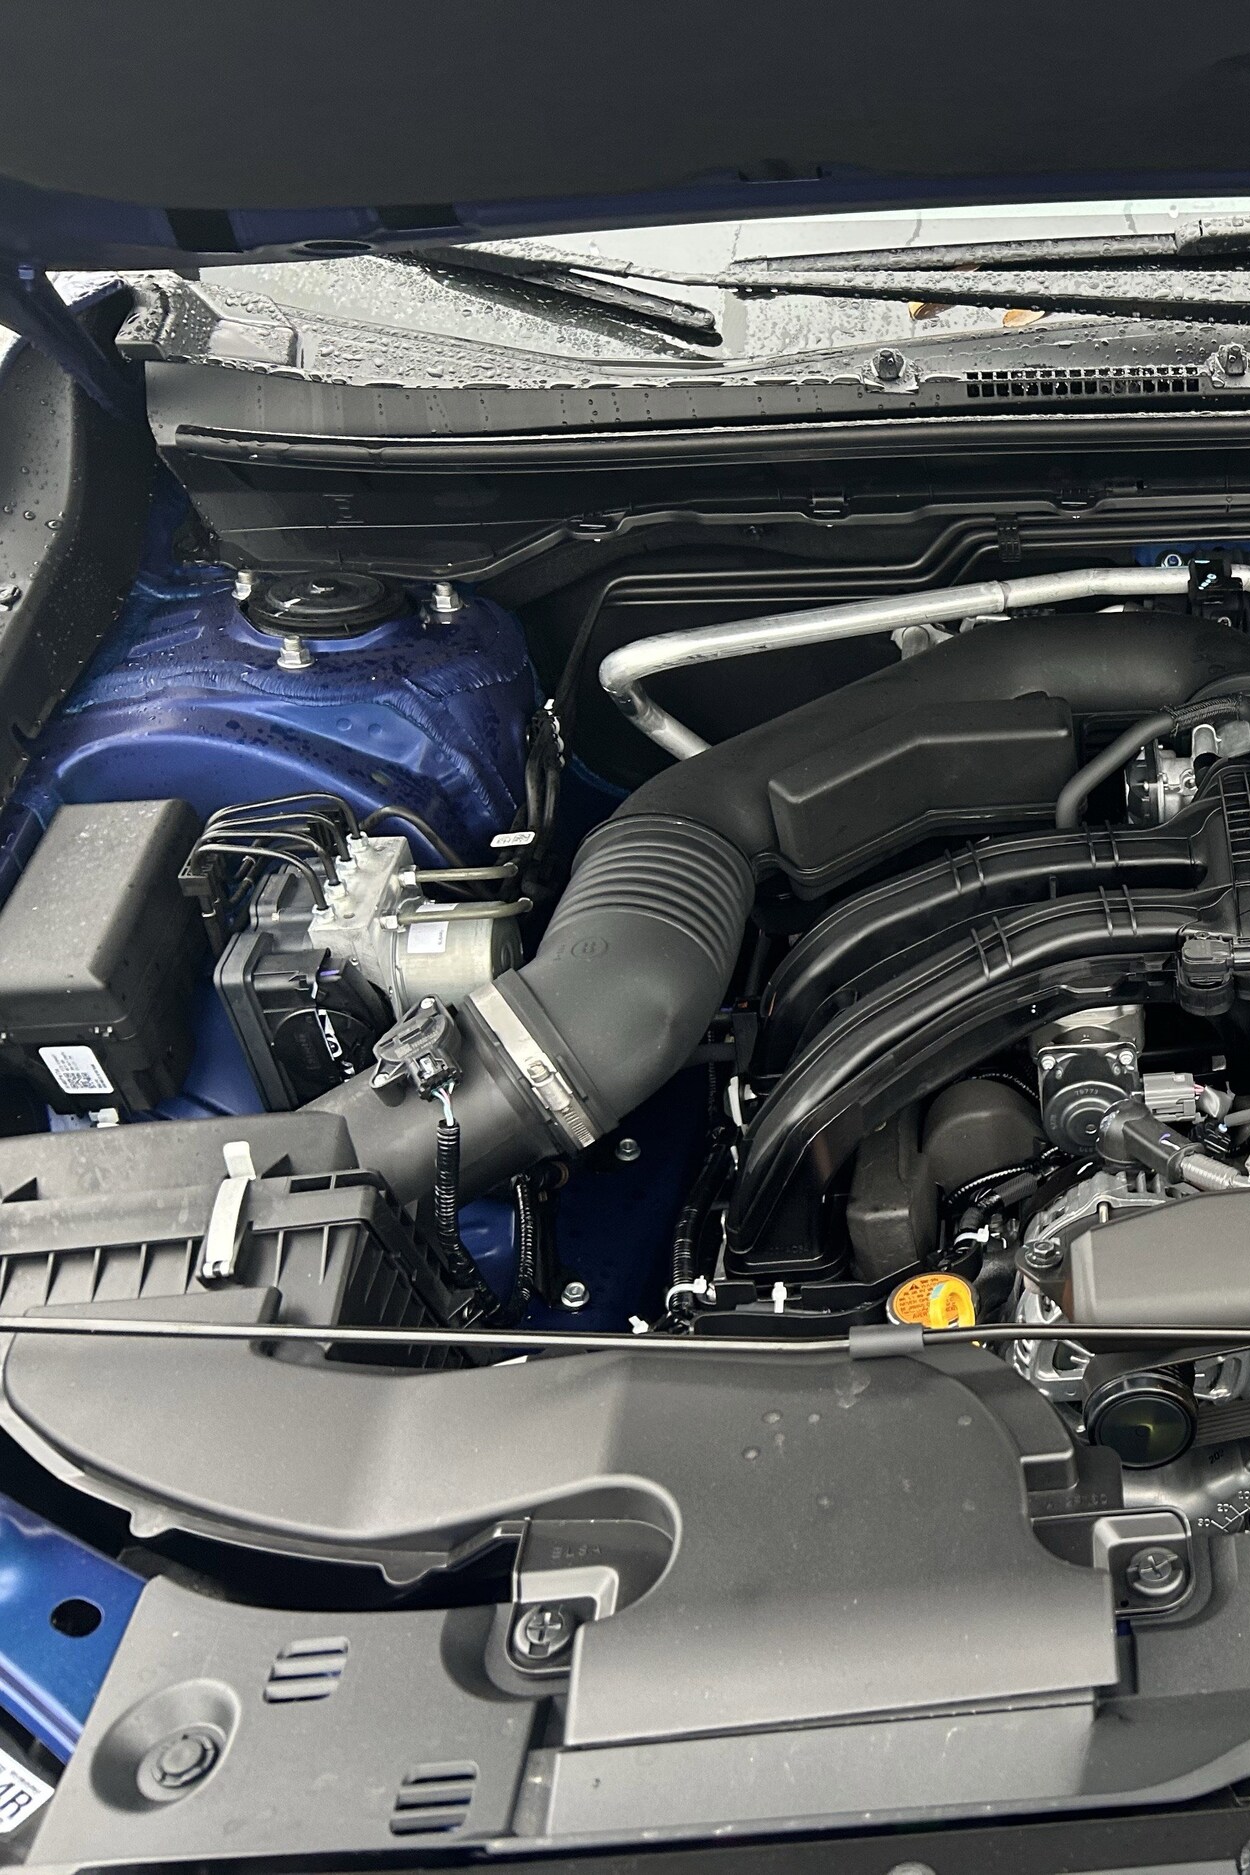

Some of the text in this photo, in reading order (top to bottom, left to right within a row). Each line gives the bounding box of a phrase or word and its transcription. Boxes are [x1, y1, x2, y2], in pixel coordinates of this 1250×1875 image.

[1238, 1490, 1250, 1499] 10
[1217, 1503, 1229, 1512] 20
[1197, 1518, 1211, 1527] 30
